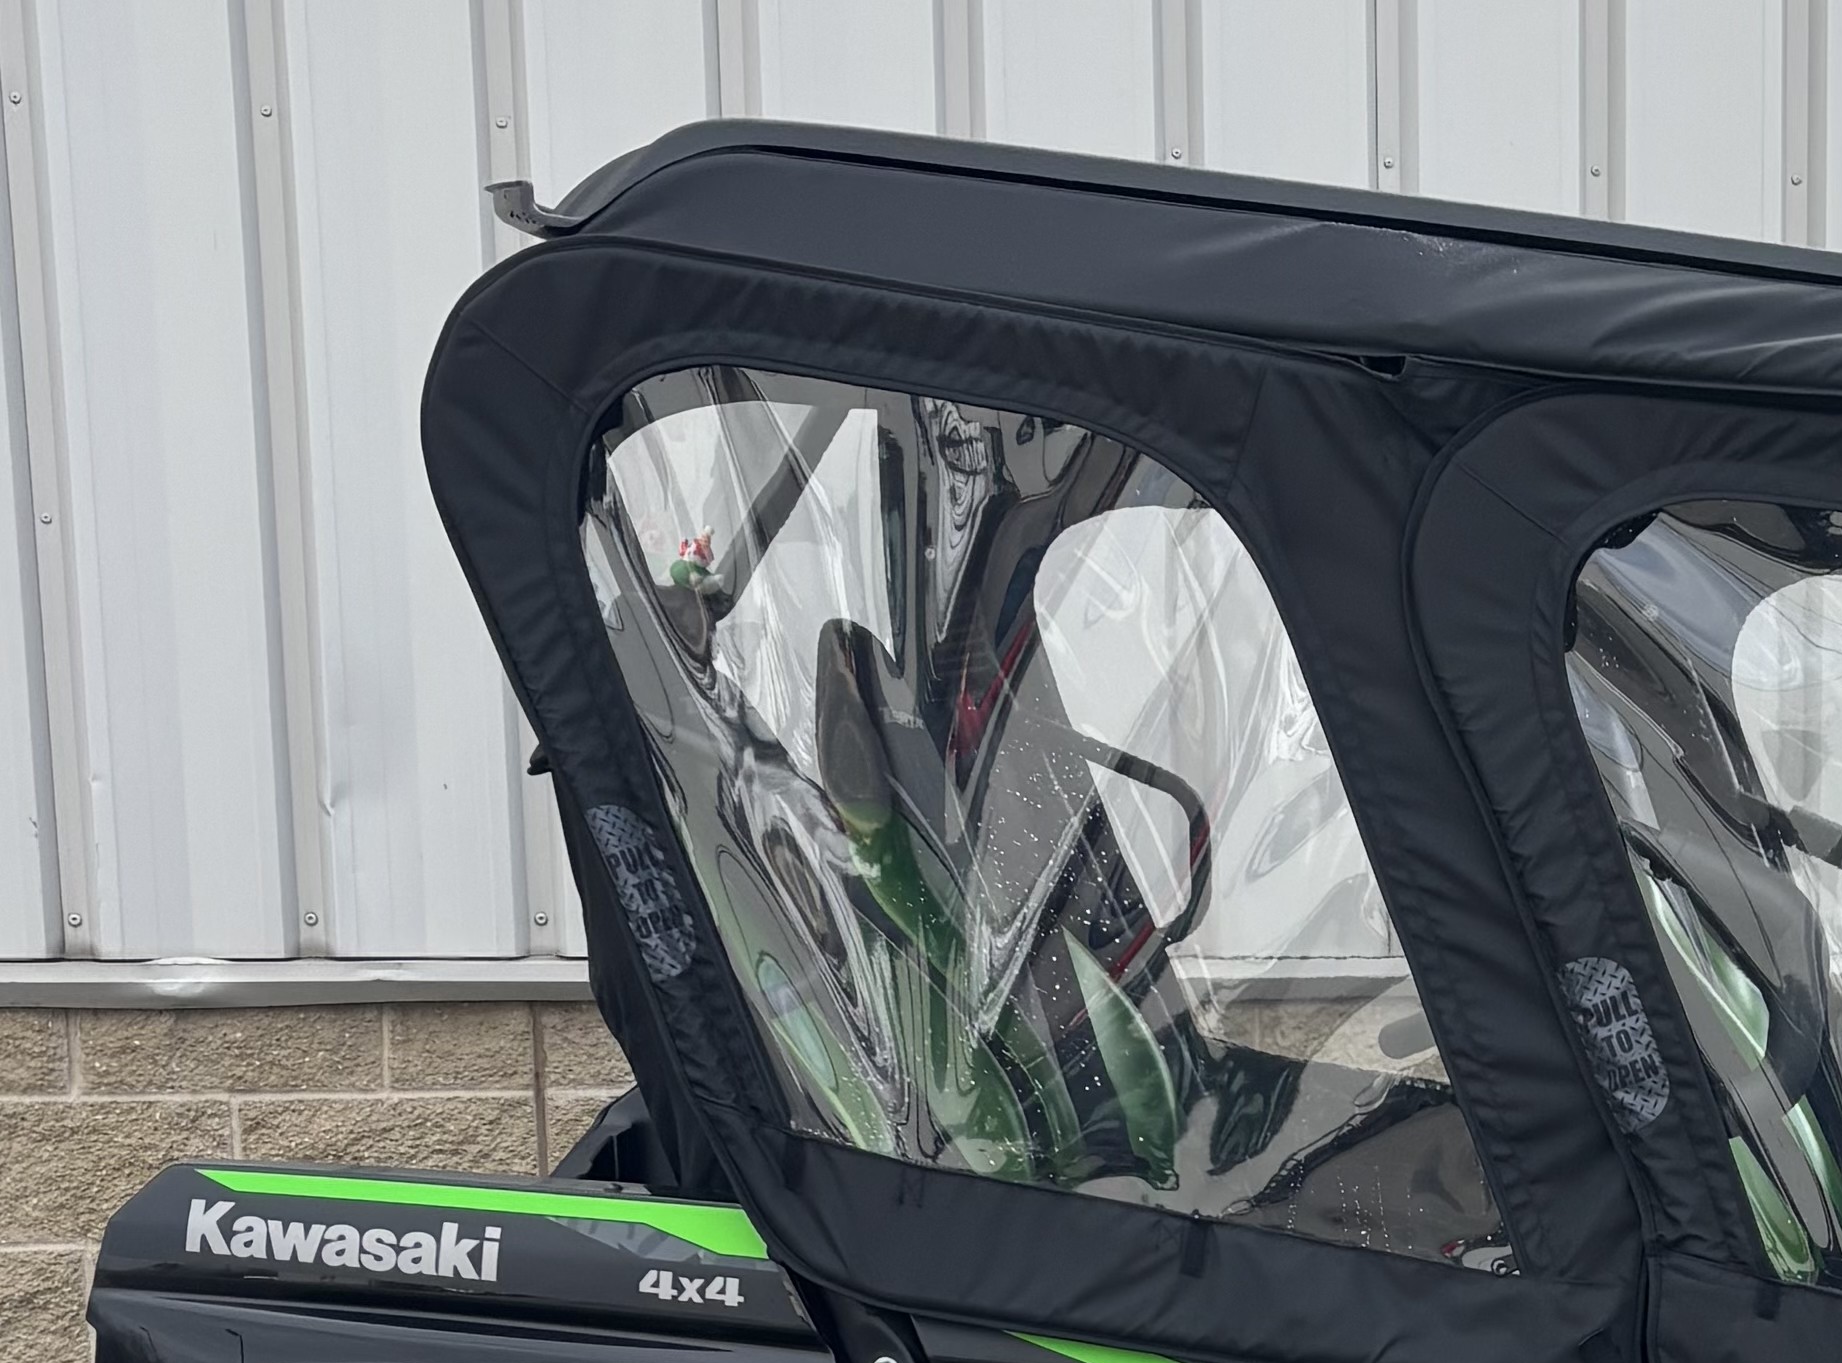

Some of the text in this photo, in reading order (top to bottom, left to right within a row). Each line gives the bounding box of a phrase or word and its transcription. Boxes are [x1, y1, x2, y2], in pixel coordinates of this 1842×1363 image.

[632, 879, 661, 905] TO
[1580, 990, 1639, 1034] PULL
[1601, 1029, 1634, 1058] TO
[1607, 1054, 1660, 1092] OPEN
[185, 1199, 502, 1282] Kawasaki
[638, 1269, 744, 1307] 4x4
